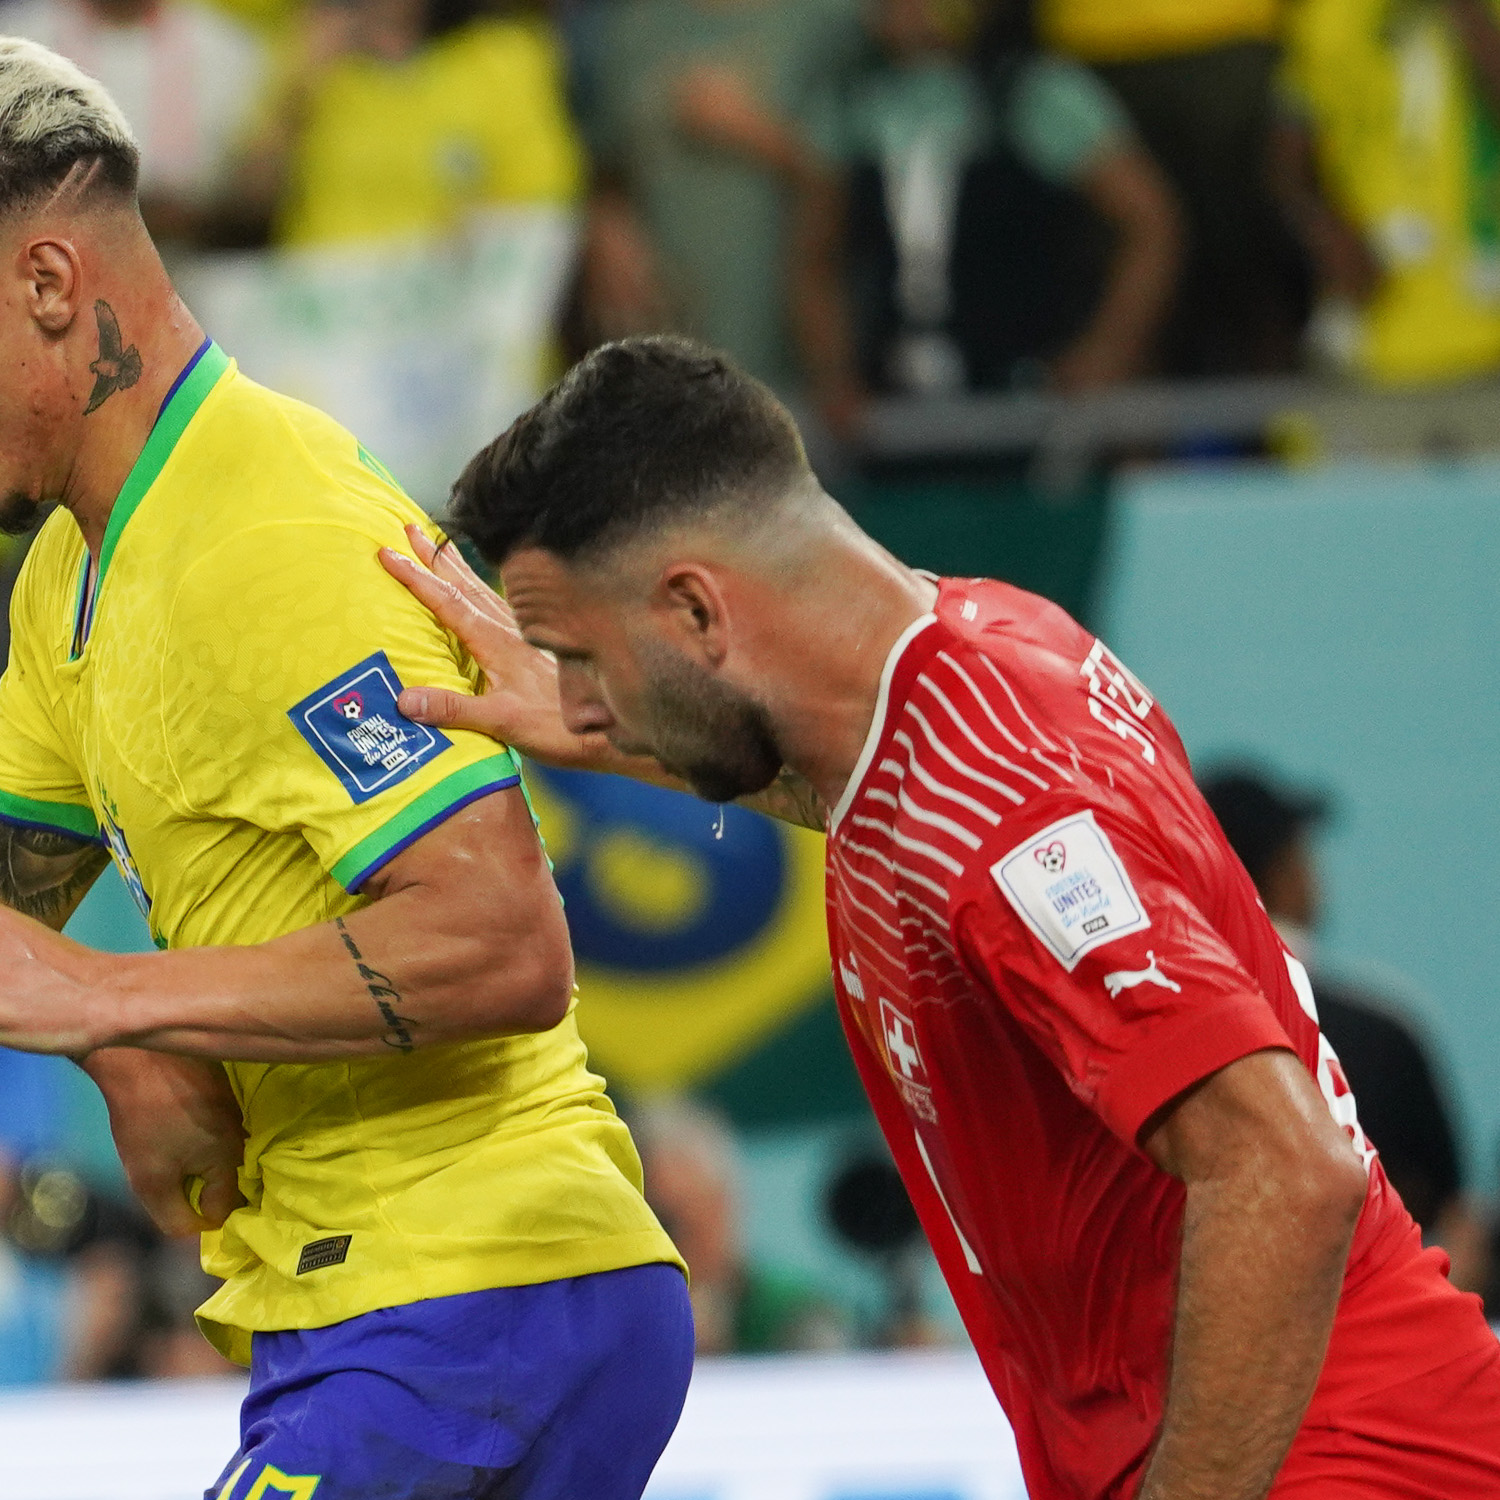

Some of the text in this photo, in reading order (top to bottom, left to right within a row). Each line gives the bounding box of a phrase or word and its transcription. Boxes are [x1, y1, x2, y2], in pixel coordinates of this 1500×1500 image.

[347, 713, 386, 741] FOOTBALL
[354, 722, 397, 754] UNITES
[363, 751, 381, 766] the
[1052, 878, 1101, 914] UNITES
